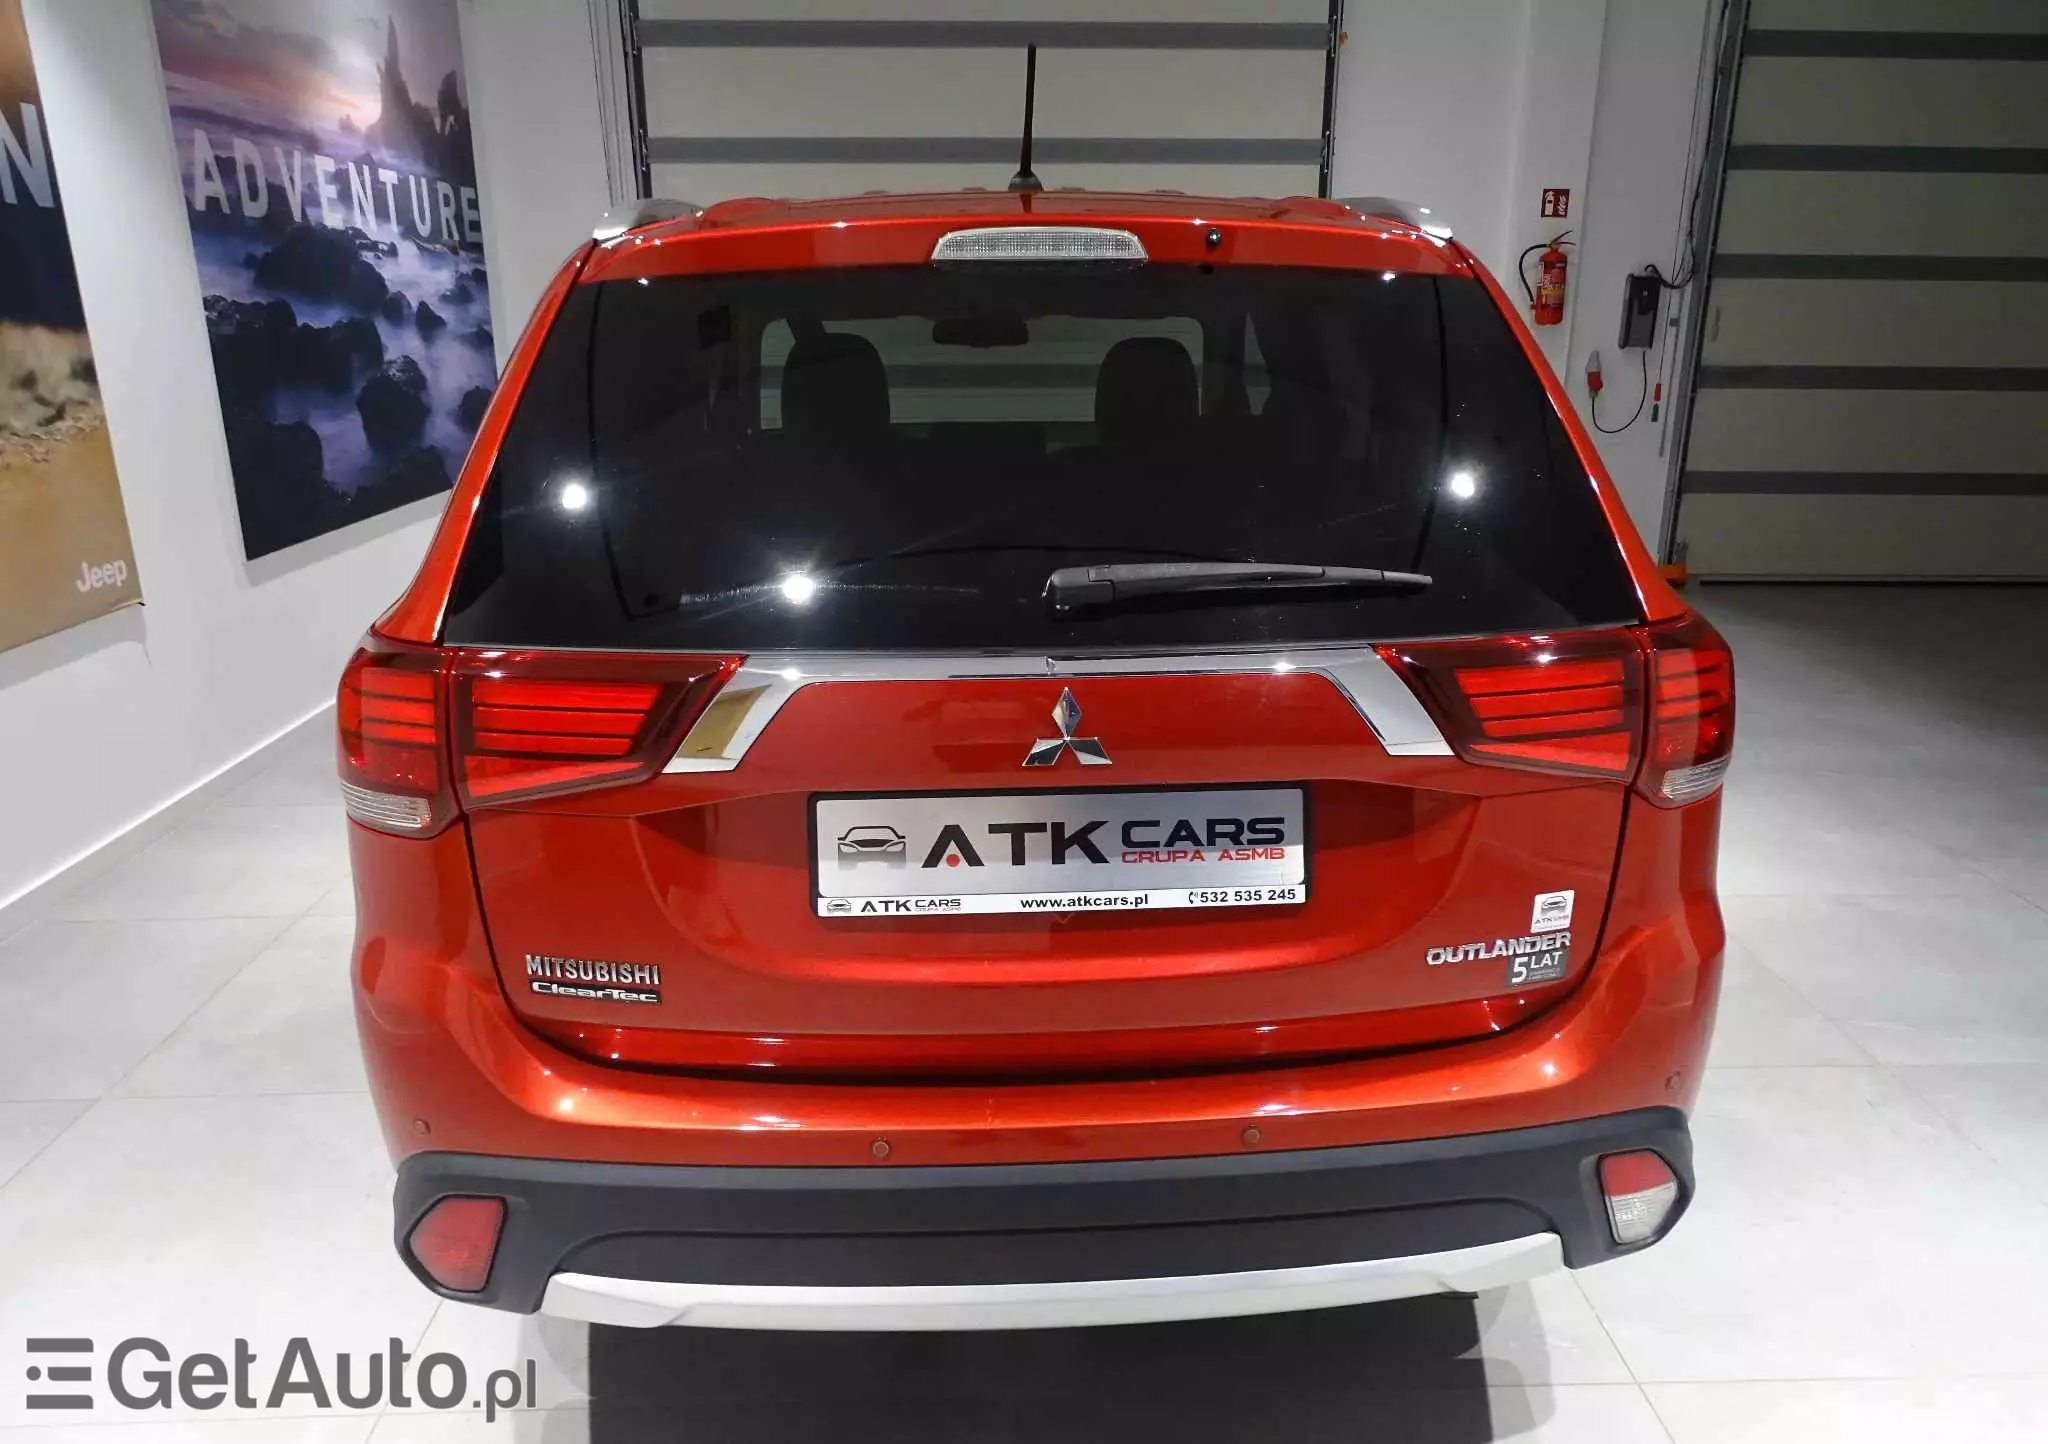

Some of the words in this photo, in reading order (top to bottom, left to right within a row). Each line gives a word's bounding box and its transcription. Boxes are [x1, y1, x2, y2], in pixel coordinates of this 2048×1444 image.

[193, 128, 482, 244] ADVENTURE
[75, 557, 128, 593] Jeep
[921, 820, 1109, 869] ATK
[1121, 817, 1286, 848] CARS
[1121, 848, 1206, 865] GRUPA
[1217, 847, 1286, 862] ASMB
[860, 899, 912, 913] ATK
[915, 898, 961, 908] CARS
[1020, 893, 1149, 910] www.atkcars.pl
[1200, 891, 1229, 903] 532
[1234, 890, 1262, 902] 535
[1267, 888, 1296, 901] 245
[1426, 931, 1571, 965] OUTLANDER
[525, 954, 660, 985] MITSUBISHI
[1511, 956, 1529, 983] 5
[1530, 951, 1563, 969] LAT
[532, 981, 658, 1002] ClearTec
